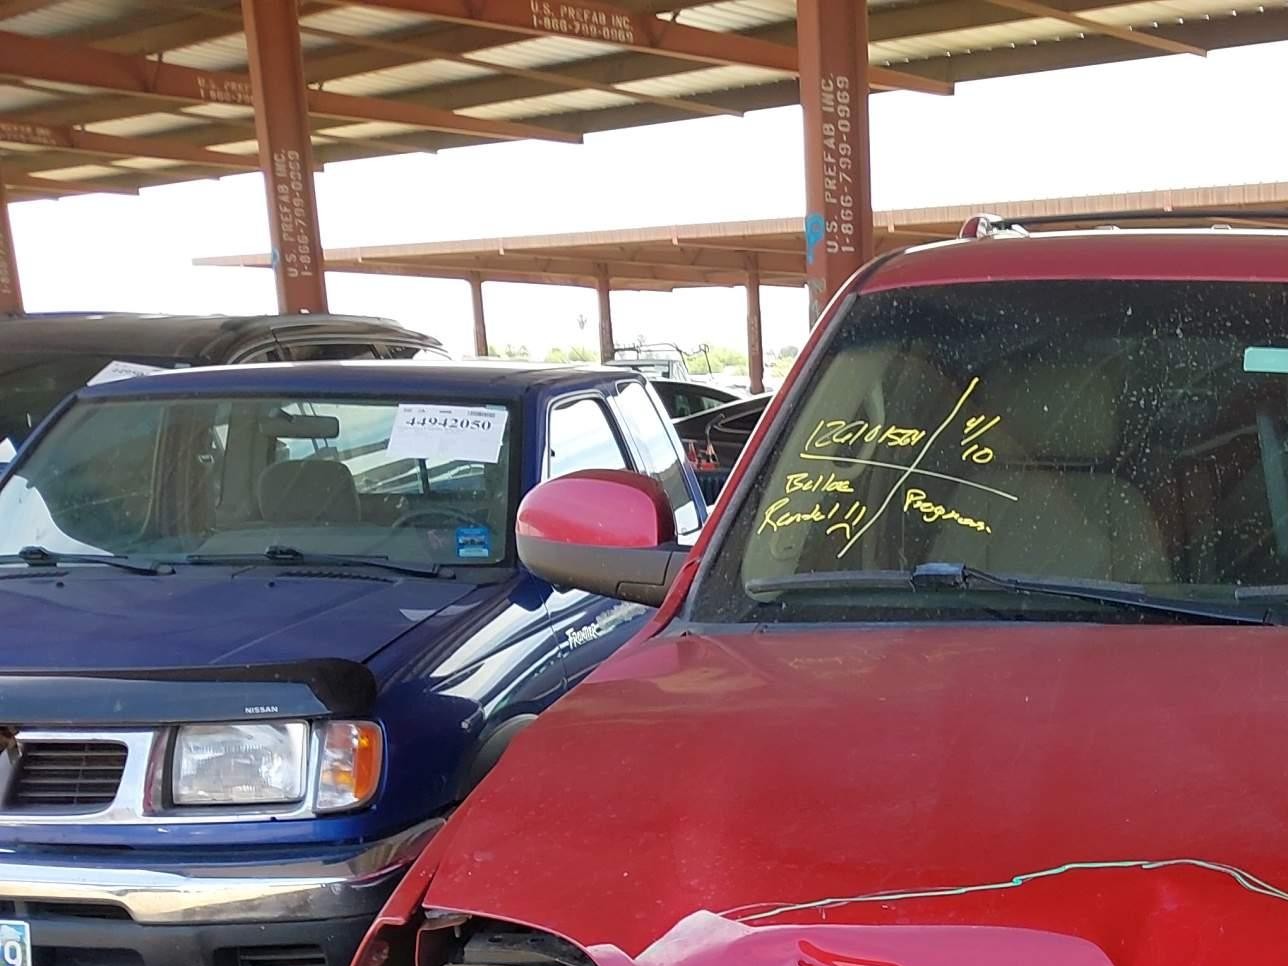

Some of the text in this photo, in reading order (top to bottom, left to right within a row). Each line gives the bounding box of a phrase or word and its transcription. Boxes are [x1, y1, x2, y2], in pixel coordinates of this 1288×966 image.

[821, 73, 840, 253] U.S. PREFAB INC.
[836, 75, 855, 252] 1-866-799-0969
[405, 417, 492, 431] 44942050
[244, 706, 279, 714] NISSAN
